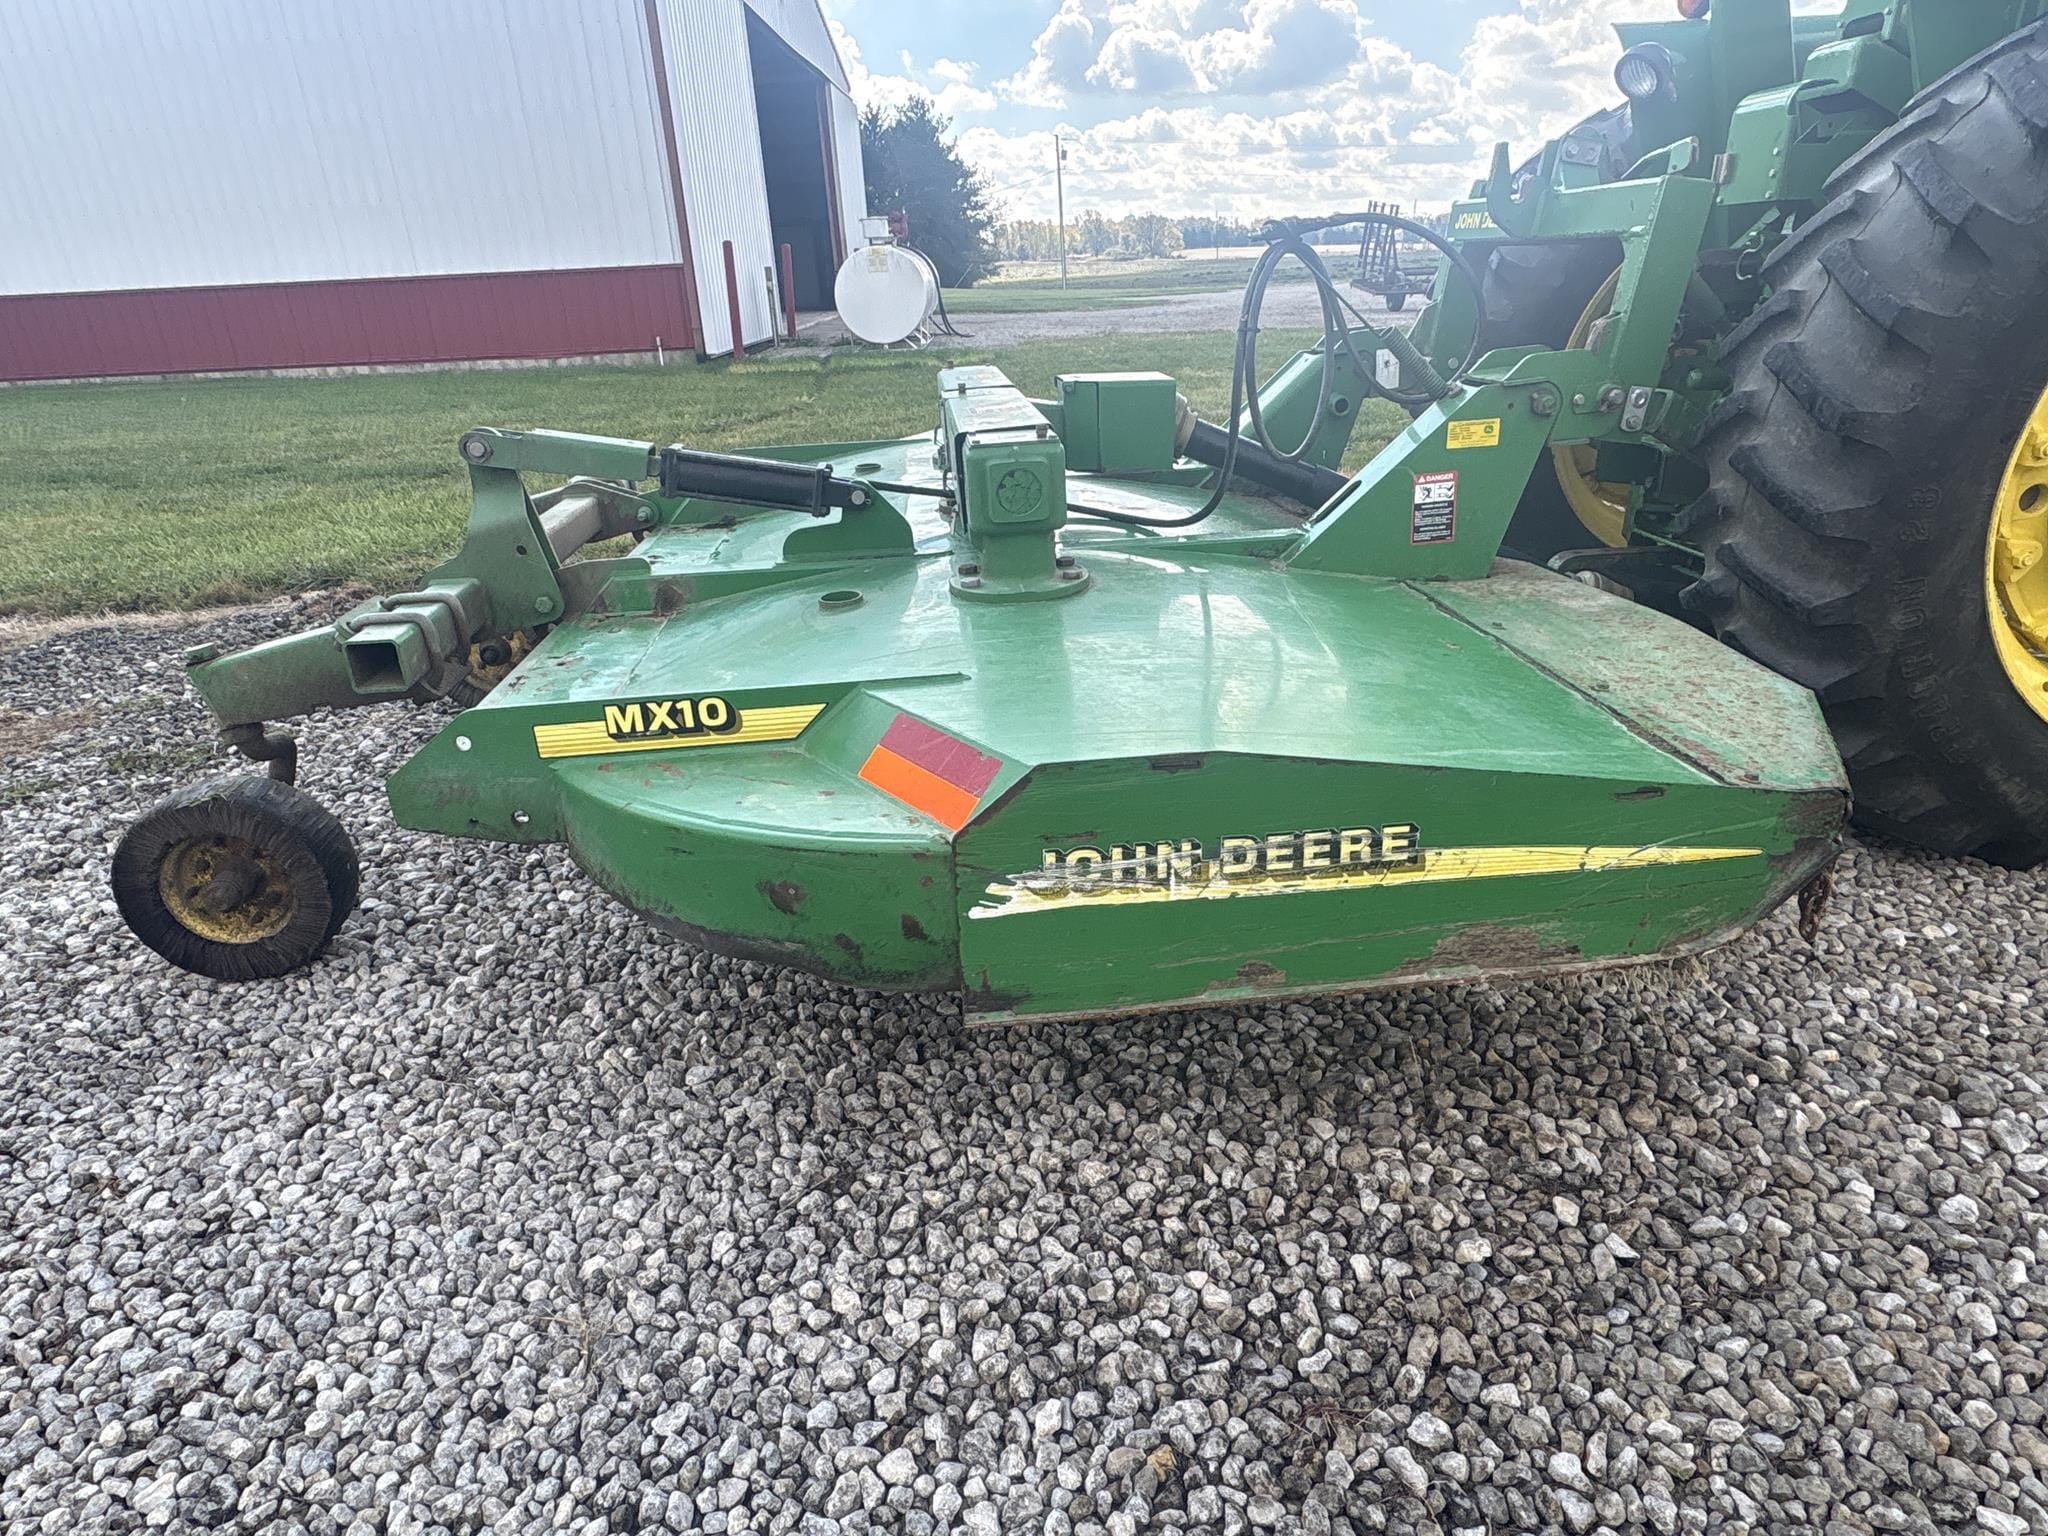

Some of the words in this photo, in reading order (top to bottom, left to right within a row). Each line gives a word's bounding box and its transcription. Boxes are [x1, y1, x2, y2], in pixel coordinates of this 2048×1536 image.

[1455, 212, 1481, 230] JOHN
[1426, 473, 1454, 482] DANGER
[604, 697, 738, 741] MX10
[1219, 822, 1421, 877] DEERE
